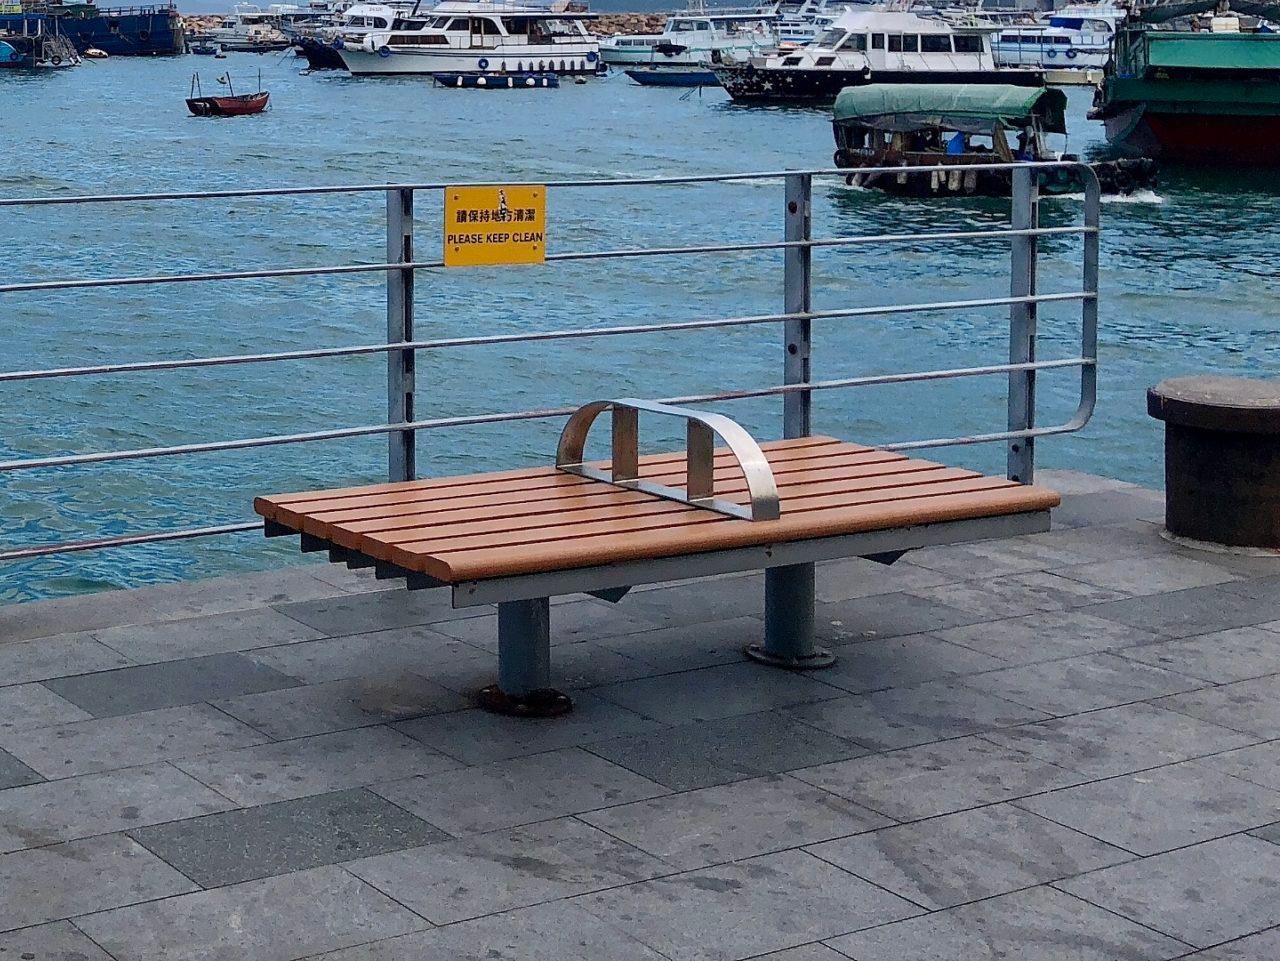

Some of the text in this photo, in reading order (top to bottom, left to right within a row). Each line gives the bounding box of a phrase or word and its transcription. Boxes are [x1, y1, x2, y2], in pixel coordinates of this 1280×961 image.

[447, 232, 543, 244] PLEASE KEEP CLEAN
